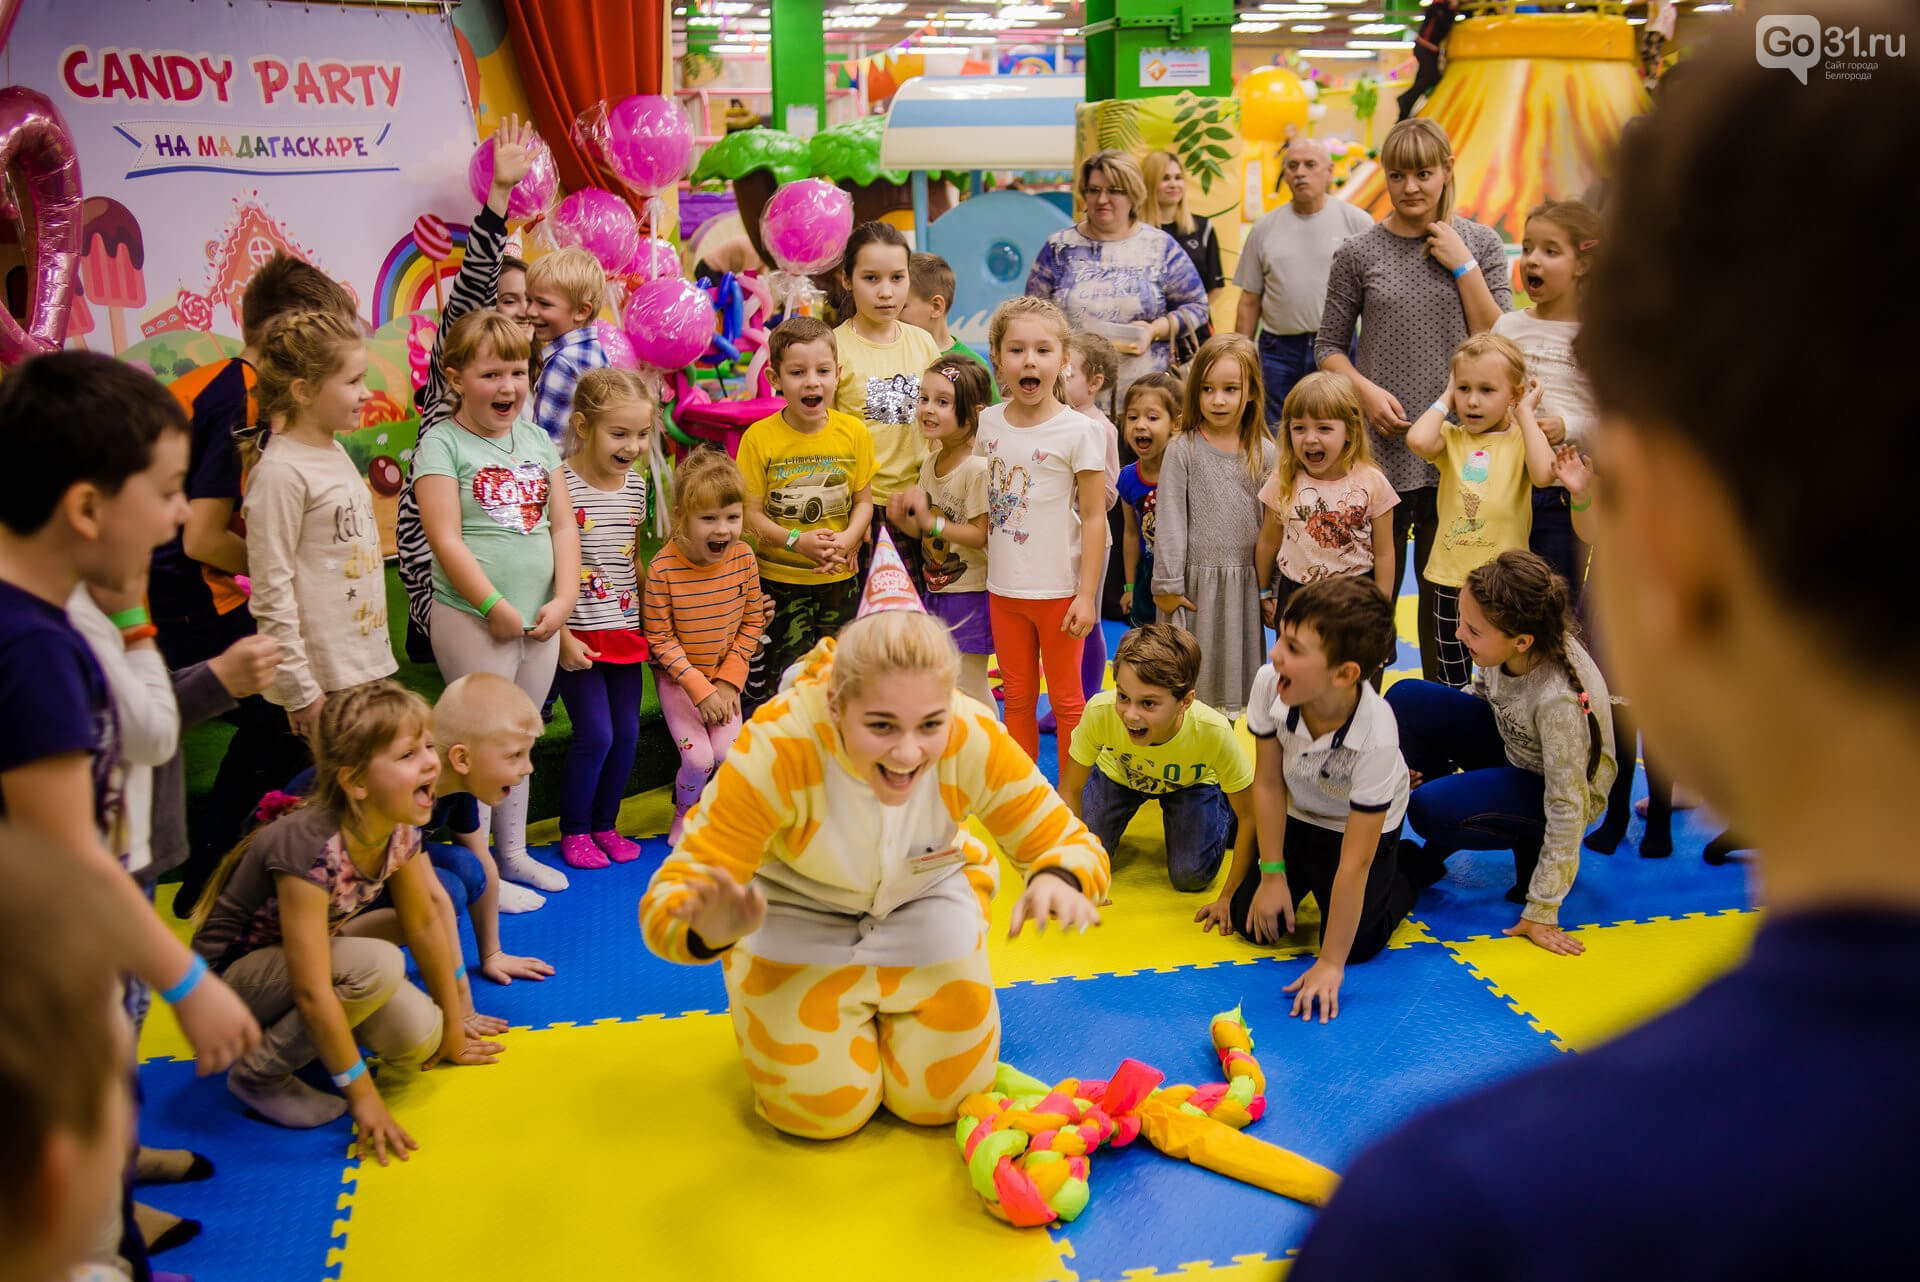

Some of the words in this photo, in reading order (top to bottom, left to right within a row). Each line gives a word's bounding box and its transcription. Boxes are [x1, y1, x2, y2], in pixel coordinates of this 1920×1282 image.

[63, 50, 232, 102] CANDY
[253, 60, 401, 107] PARTY
[154, 134, 192, 157] НА
[197, 135, 368, 158] МАДАГАСКАРЕ
